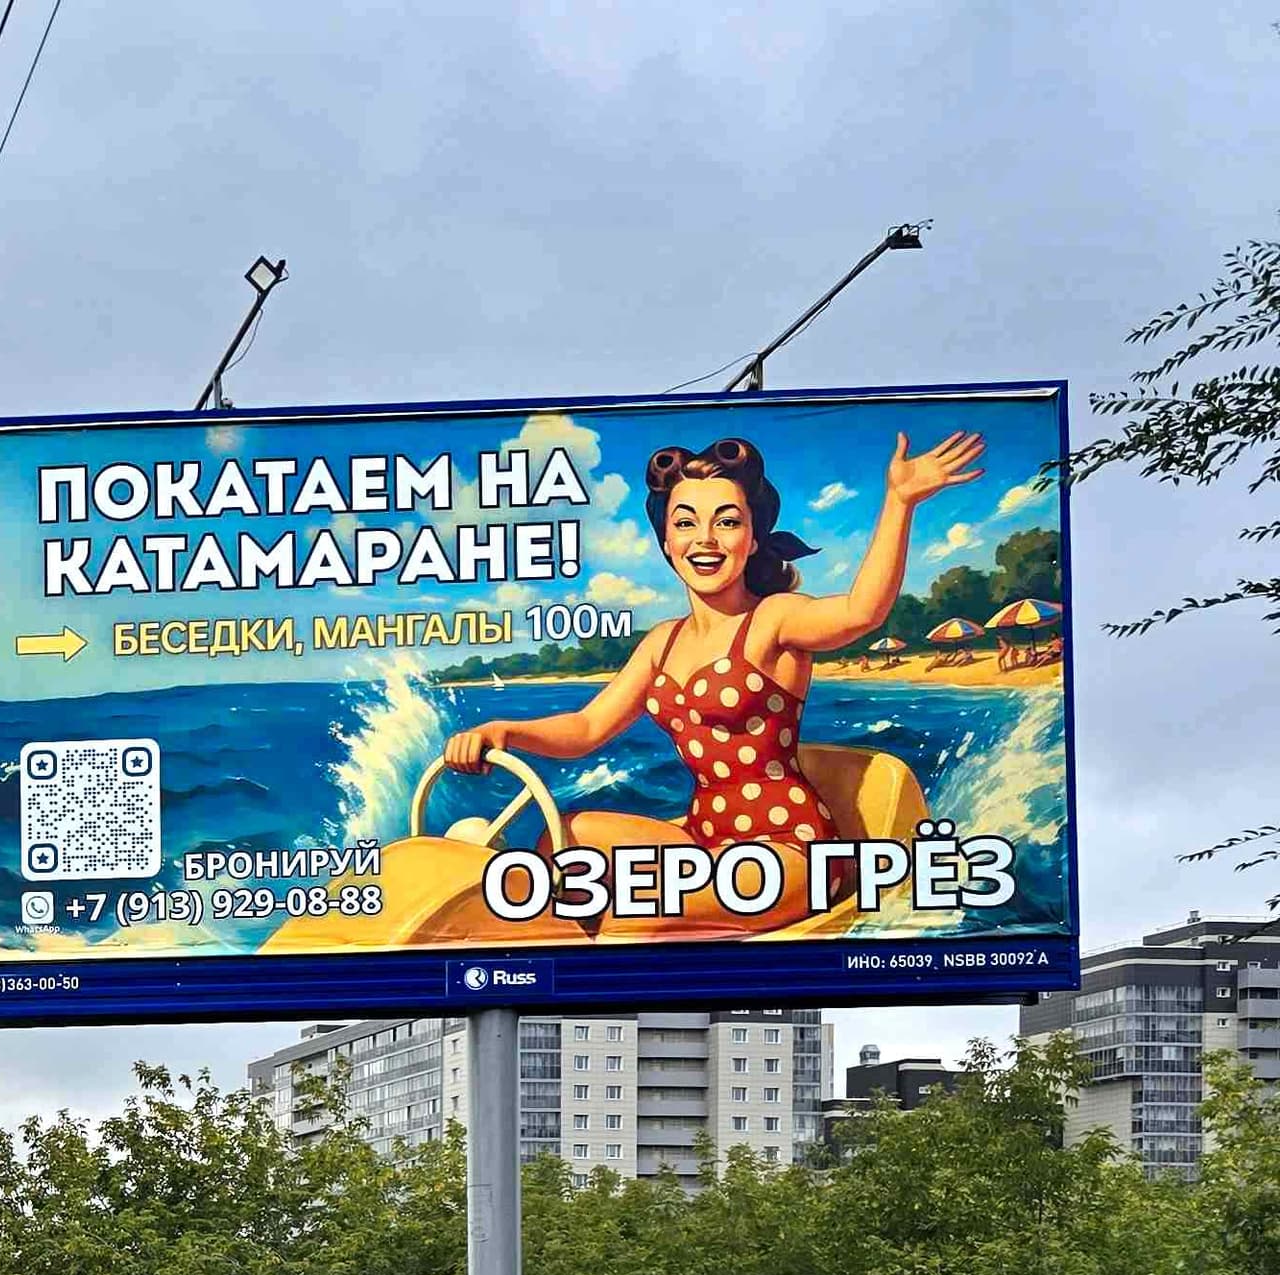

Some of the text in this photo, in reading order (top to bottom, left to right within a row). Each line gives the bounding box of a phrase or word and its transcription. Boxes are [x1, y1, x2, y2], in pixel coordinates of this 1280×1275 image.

[39, 448, 589, 523] ПОКАТАЕМ НА
[44, 521, 581, 597] КАТАМАРАНЕ!
[113, 619, 303, 657] БЕСЕДКИ,
[313, 610, 512, 650] МАНГАЛЫ
[184, 839, 381, 881] БРОНИРУЙ
[482, 818, 1017, 921] ОЗЕРО ГРЁЗ
[65, 886, 382, 926] +7 (913) 929-08-88
[493, 970, 537, 985] Russ
[847, 954, 933, 969] ИНО: 65039
[944, 953, 987, 967] NSBB
[990, 952, 1034, 966] 30092
